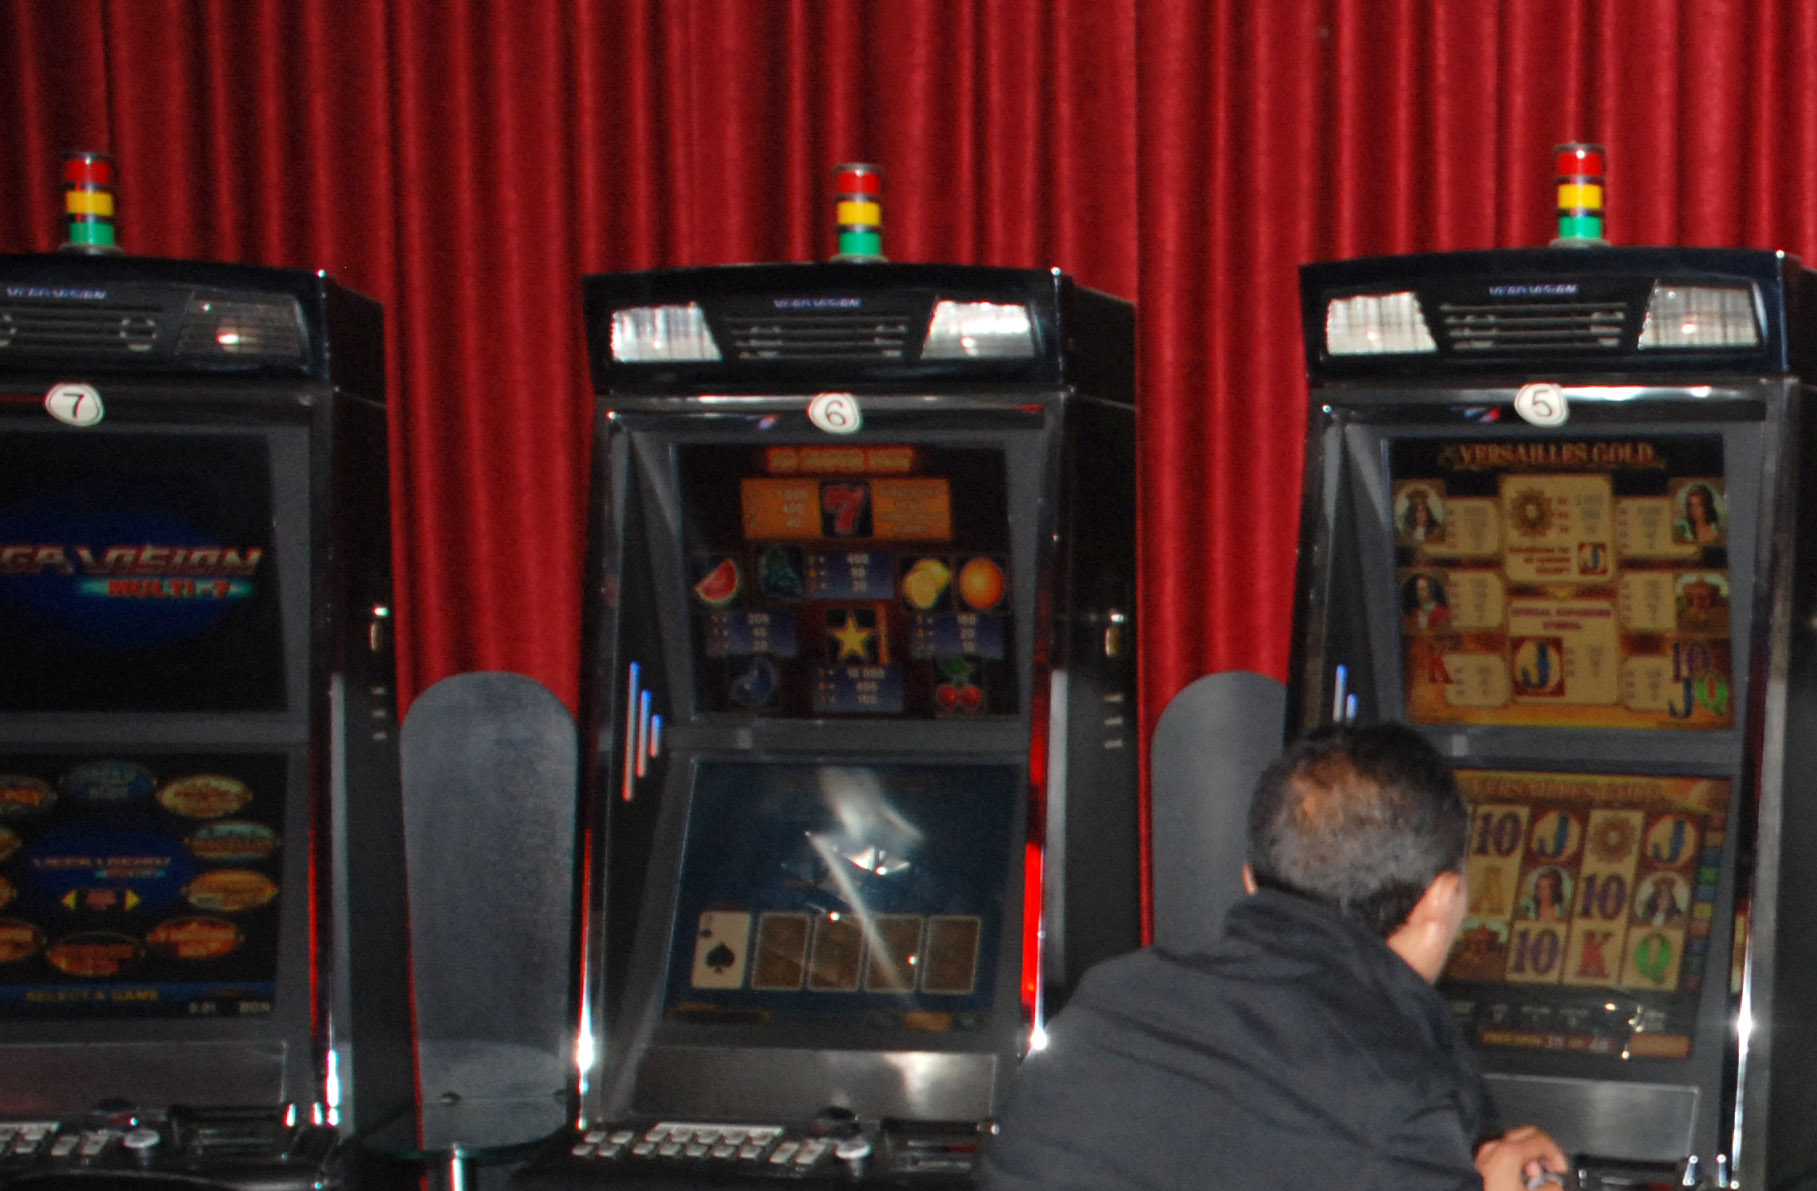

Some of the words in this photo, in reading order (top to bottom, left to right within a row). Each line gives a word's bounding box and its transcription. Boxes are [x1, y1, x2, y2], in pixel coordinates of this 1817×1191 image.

[62, 392, 86, 419] 7
[825, 400, 847, 427] 6
[1532, 389, 1554, 417] 5
[1458, 441, 1589, 465] VERSAILLES
[1590, 440, 1656, 464] GOLD
[823, 485, 865, 534] 7
[75, 545, 263, 575] VISION
[107, 579, 230, 598] MULTI-7
[1521, 642, 1550, 690] J
[1669, 677, 1694, 719] J
[1474, 812, 1523, 858] 10
[1535, 814, 1571, 858] J
[1650, 819, 1687, 865] J
[1582, 873, 1628, 921] 10
[1513, 928, 1561, 975] 10
[1577, 930, 1616, 979] K
[1635, 932, 1673, 986] Q
